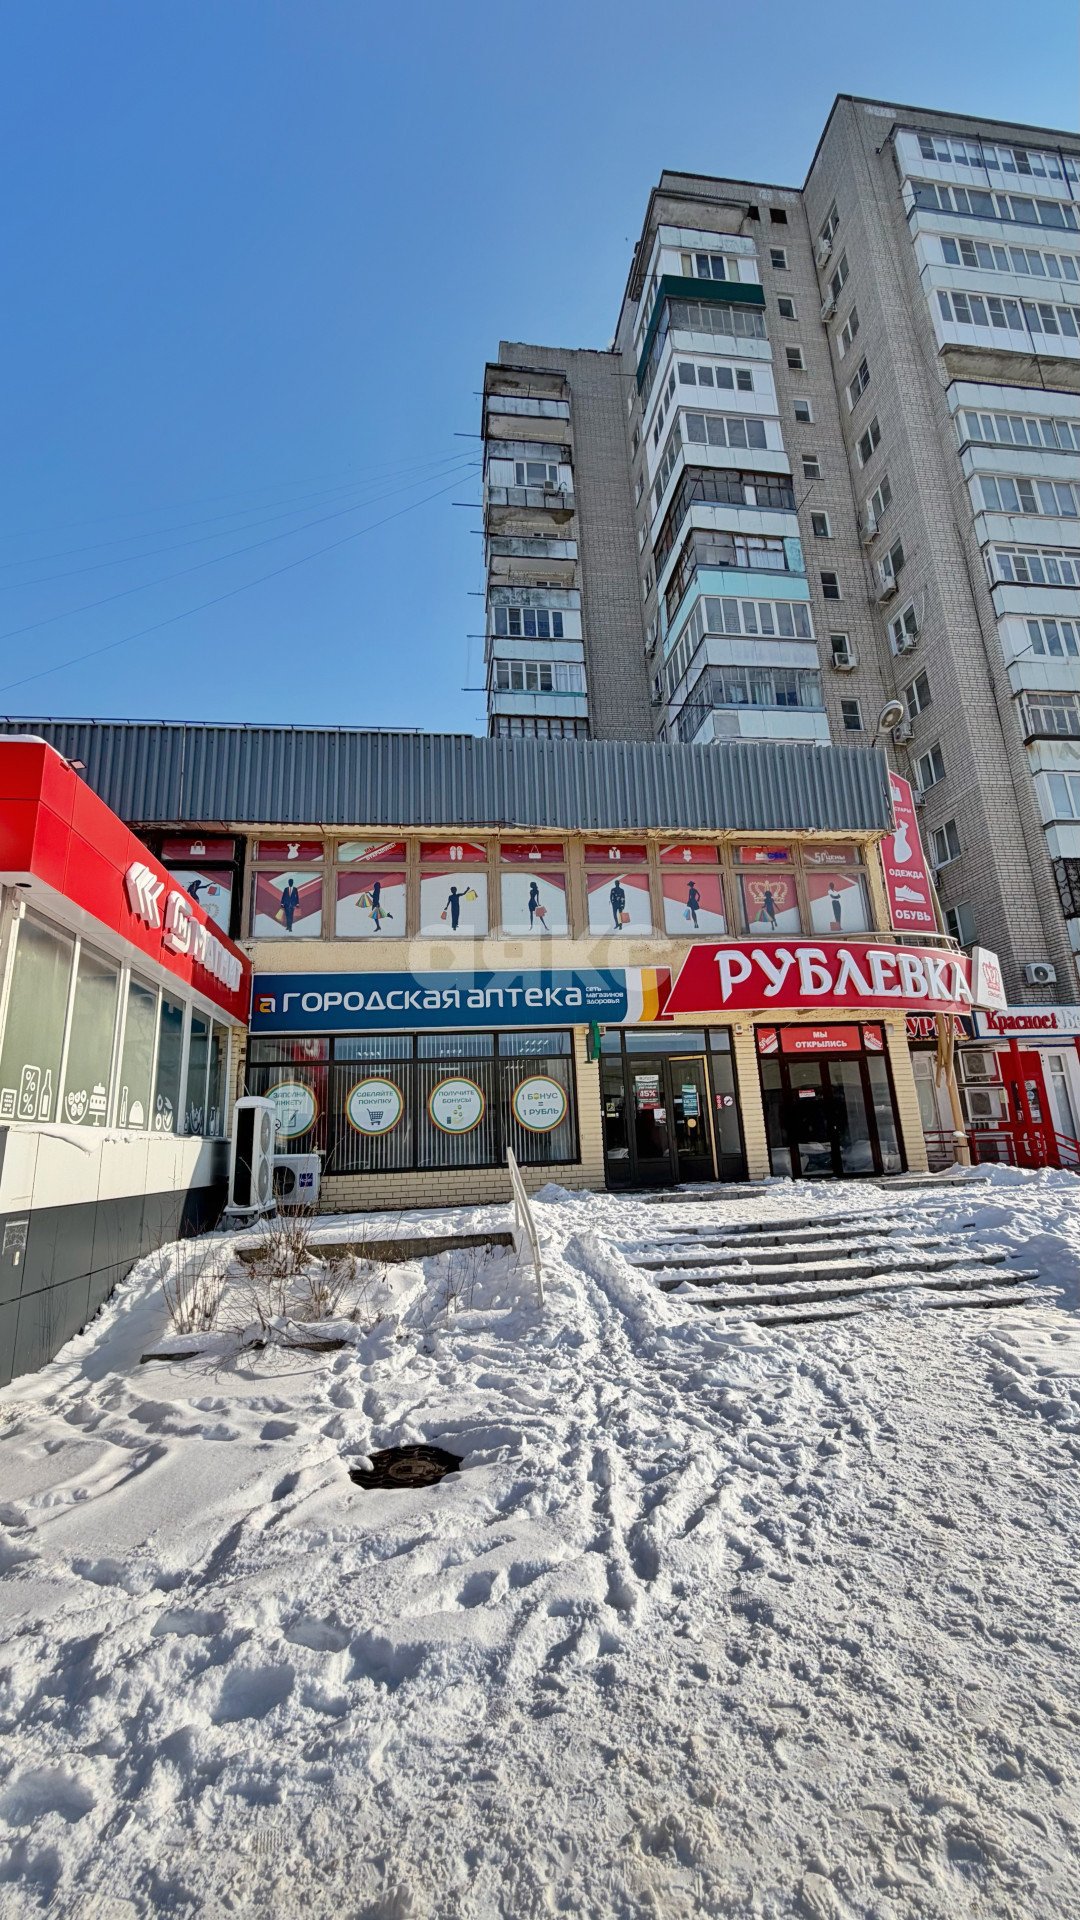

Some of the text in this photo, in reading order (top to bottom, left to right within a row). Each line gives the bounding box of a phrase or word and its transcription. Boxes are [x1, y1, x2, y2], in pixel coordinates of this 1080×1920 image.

[889, 868, 924, 879] ОДЕЖДА
[895, 909, 932, 922] ОБУВЬ
[714, 948, 975, 1004] РУБЛЕВКА
[795, 1040, 848, 1049] ОТКРЫЛИСЬ
[527, 1092, 559, 1101] БОНУС
[529, 1108, 560, 1116] РУБЛЬ
